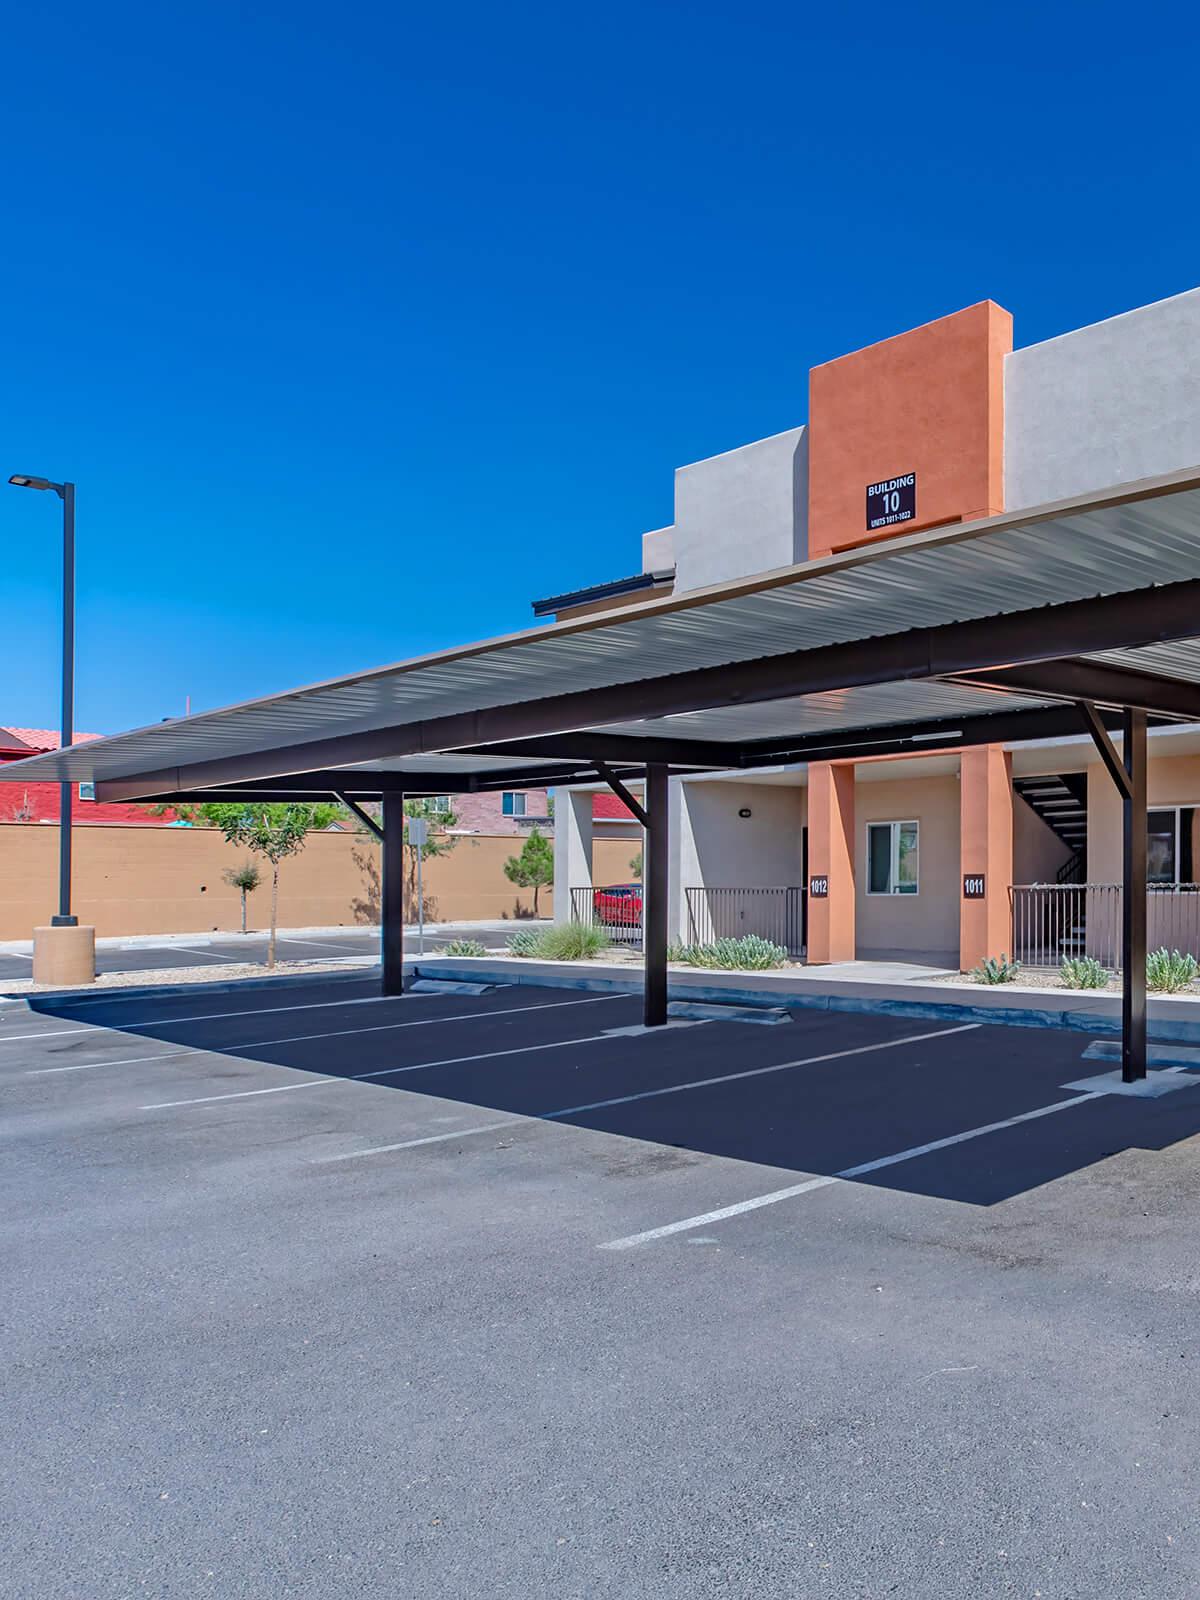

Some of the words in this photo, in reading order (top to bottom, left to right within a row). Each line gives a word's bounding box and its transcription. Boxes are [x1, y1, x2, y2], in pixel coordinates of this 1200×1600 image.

[868, 475, 914, 496] BUILDING
[883, 491, 900, 514] 10
[870, 516, 886, 528] UNITS
[811, 879, 827, 893] 1012
[965, 879, 983, 893] 1011
